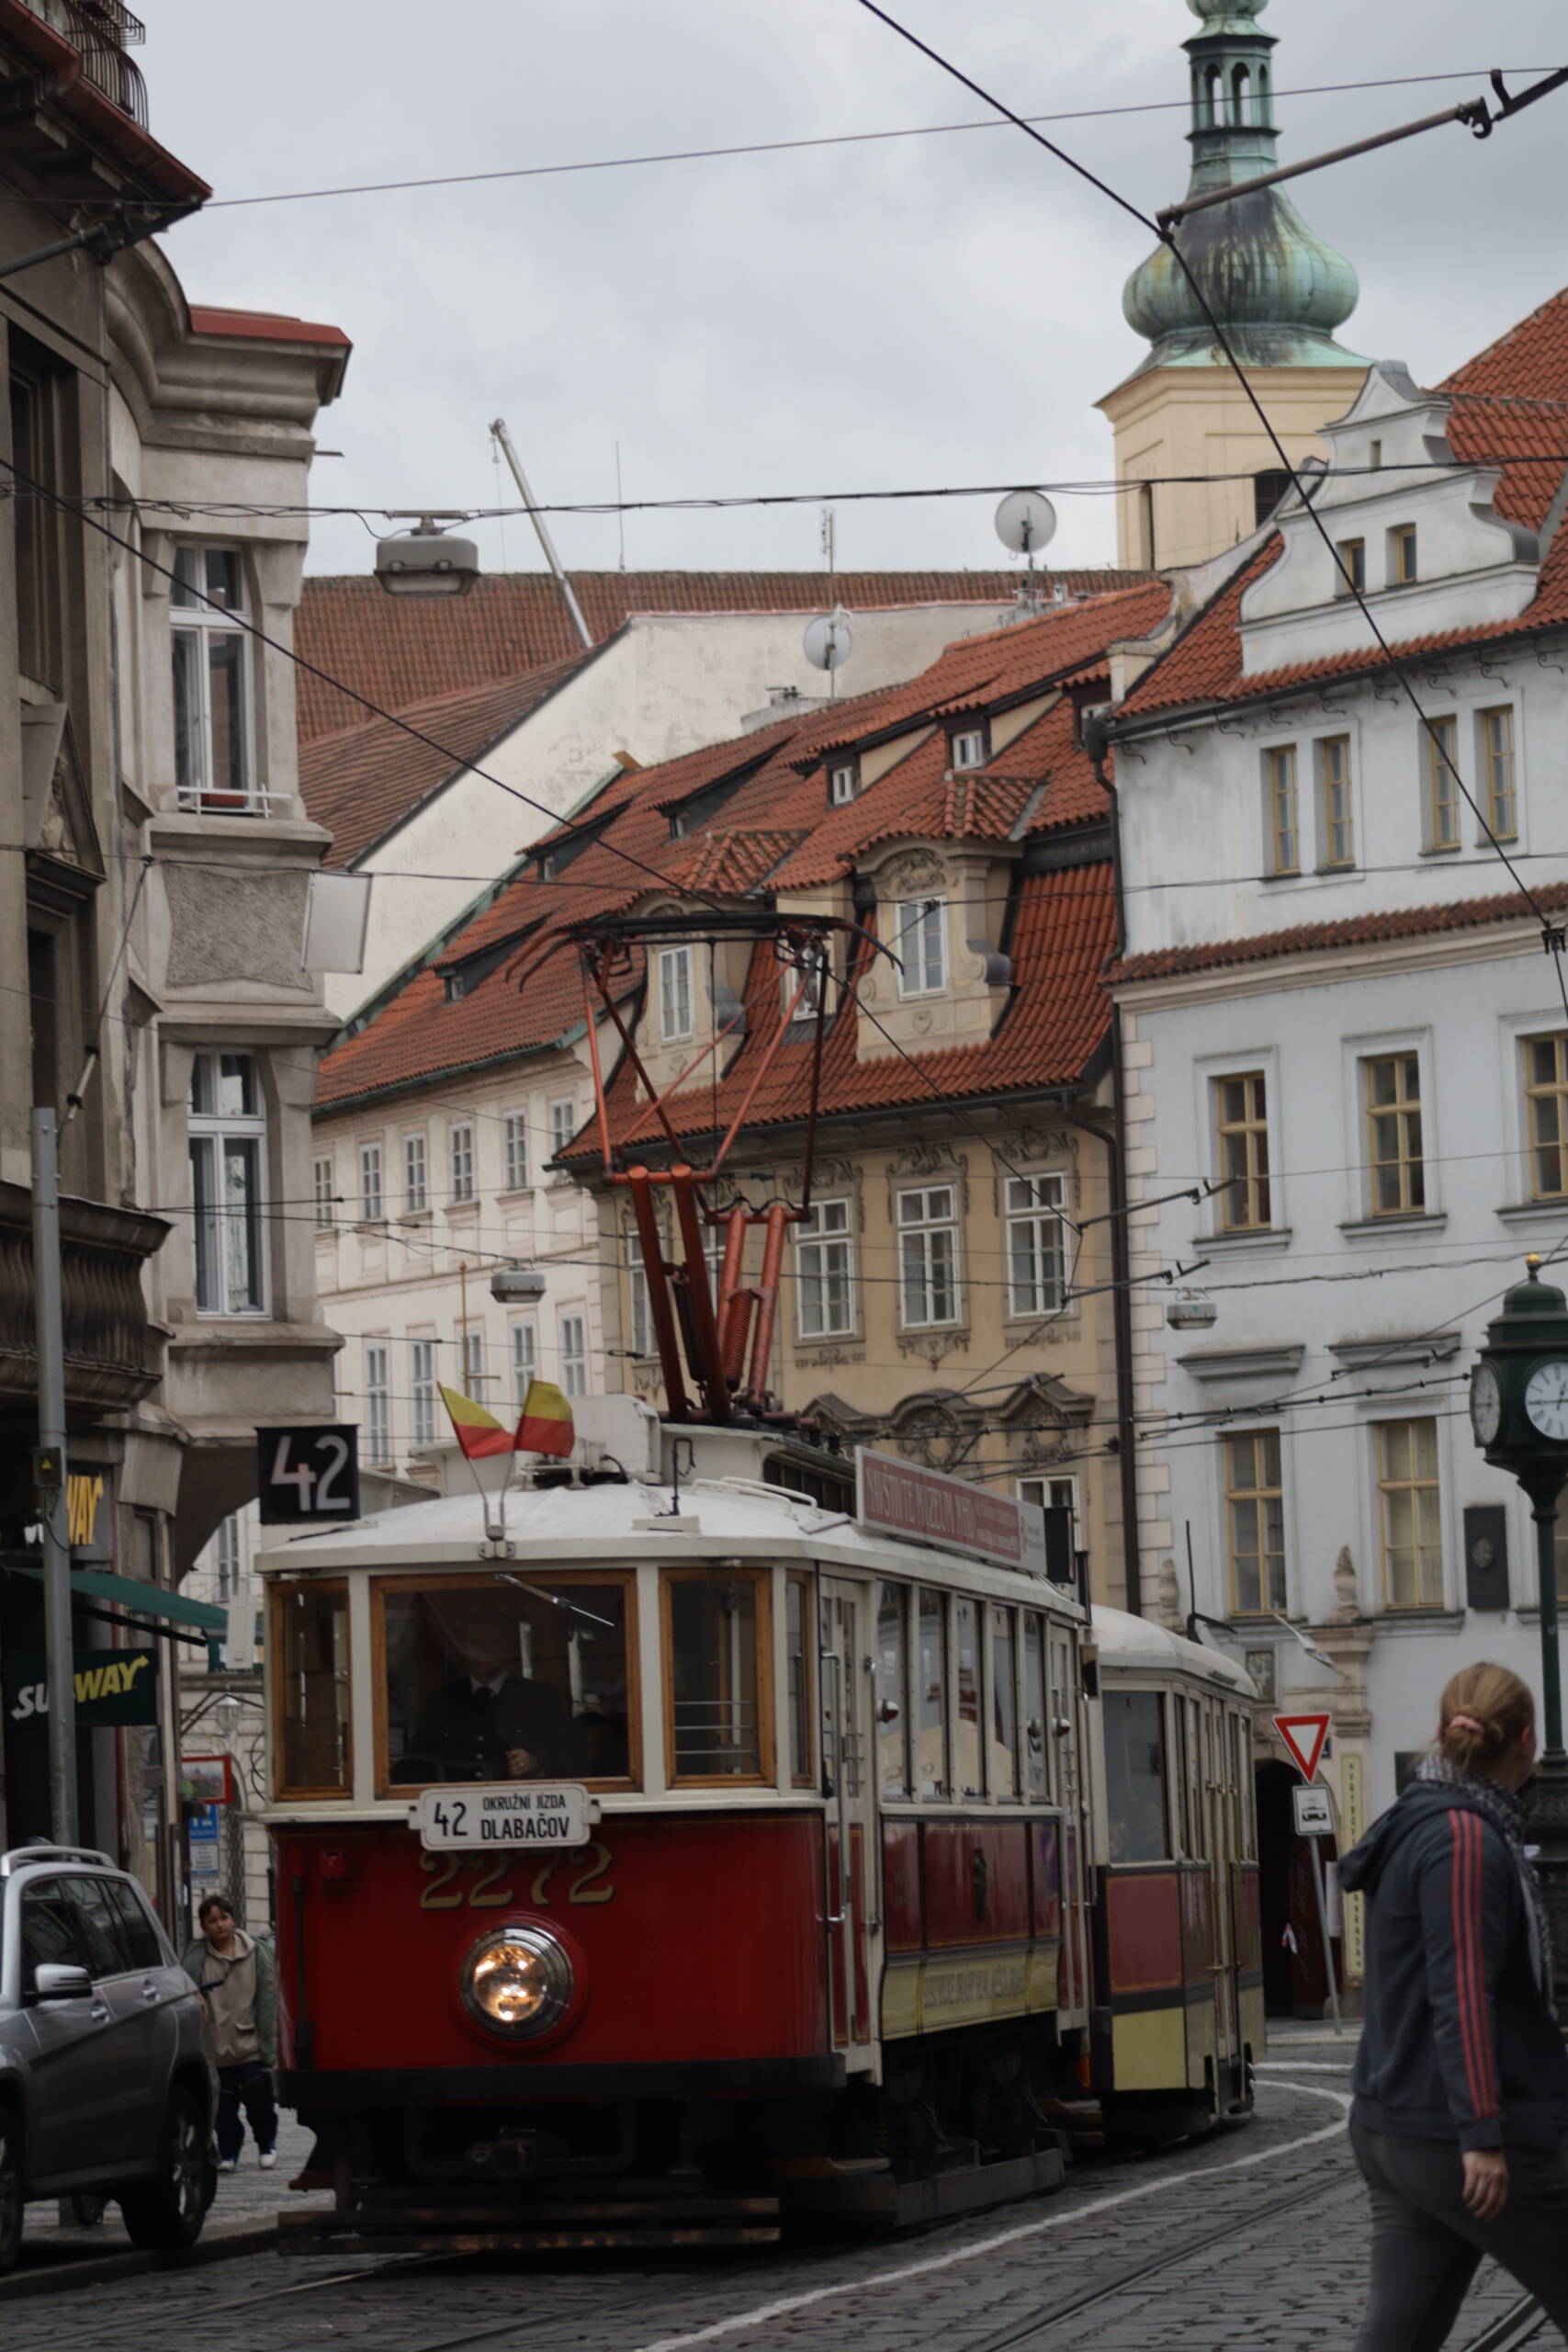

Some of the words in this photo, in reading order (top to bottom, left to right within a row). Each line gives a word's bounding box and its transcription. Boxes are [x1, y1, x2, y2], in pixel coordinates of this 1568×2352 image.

[270, 1434, 352, 1512] 42
[10, 1654, 150, 1721] SUWAY
[434, 1802, 468, 1838] 42
[479, 1813, 570, 1840] DLABAČOV
[482, 1792, 531, 1811] OKRUŽNÍ
[536, 1792, 566, 1810] JÍZDA
[419, 1843, 615, 1909] 2272
